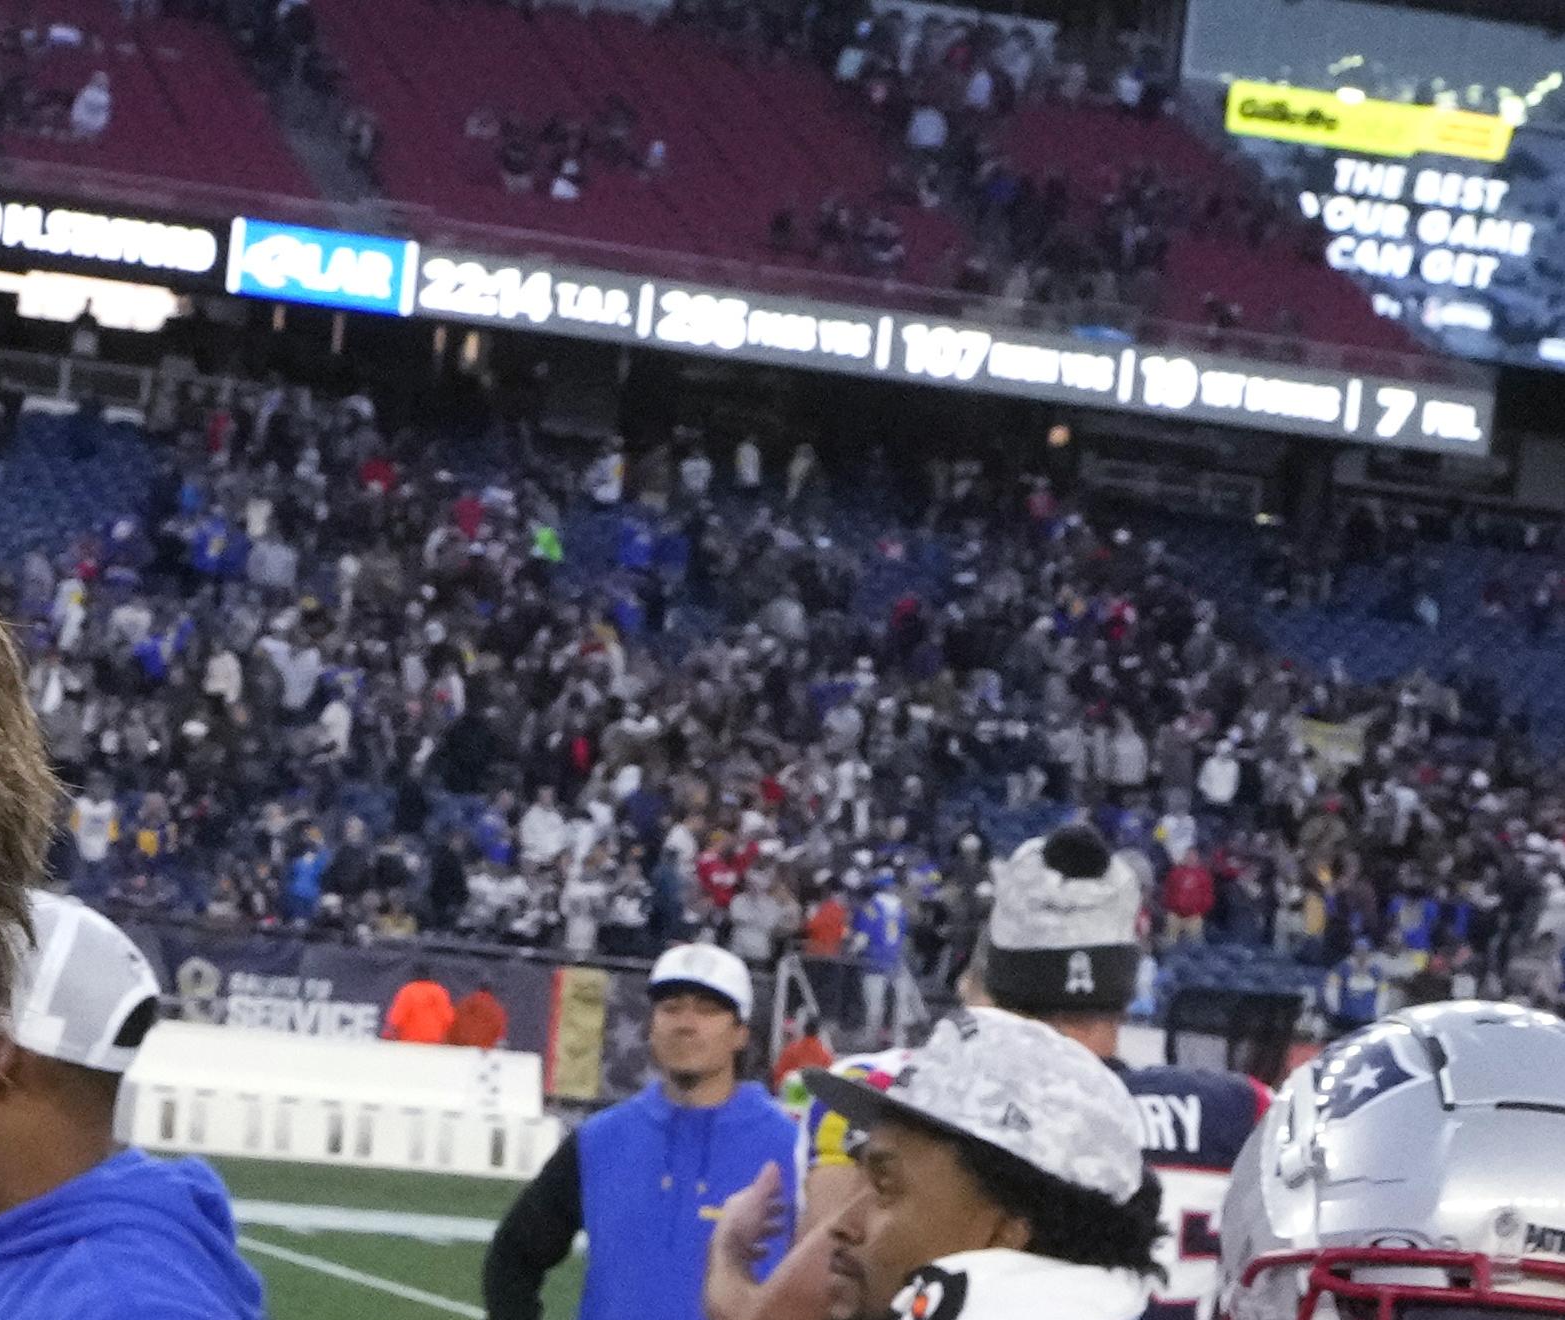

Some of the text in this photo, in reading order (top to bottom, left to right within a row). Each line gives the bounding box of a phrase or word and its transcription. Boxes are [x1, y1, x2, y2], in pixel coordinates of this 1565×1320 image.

[901, 323, 991, 381] 107
[1375, 387, 1417, 438] 7
[228, 998, 380, 1037] SERVICE
[1132, 1094, 1202, 1152] RY
